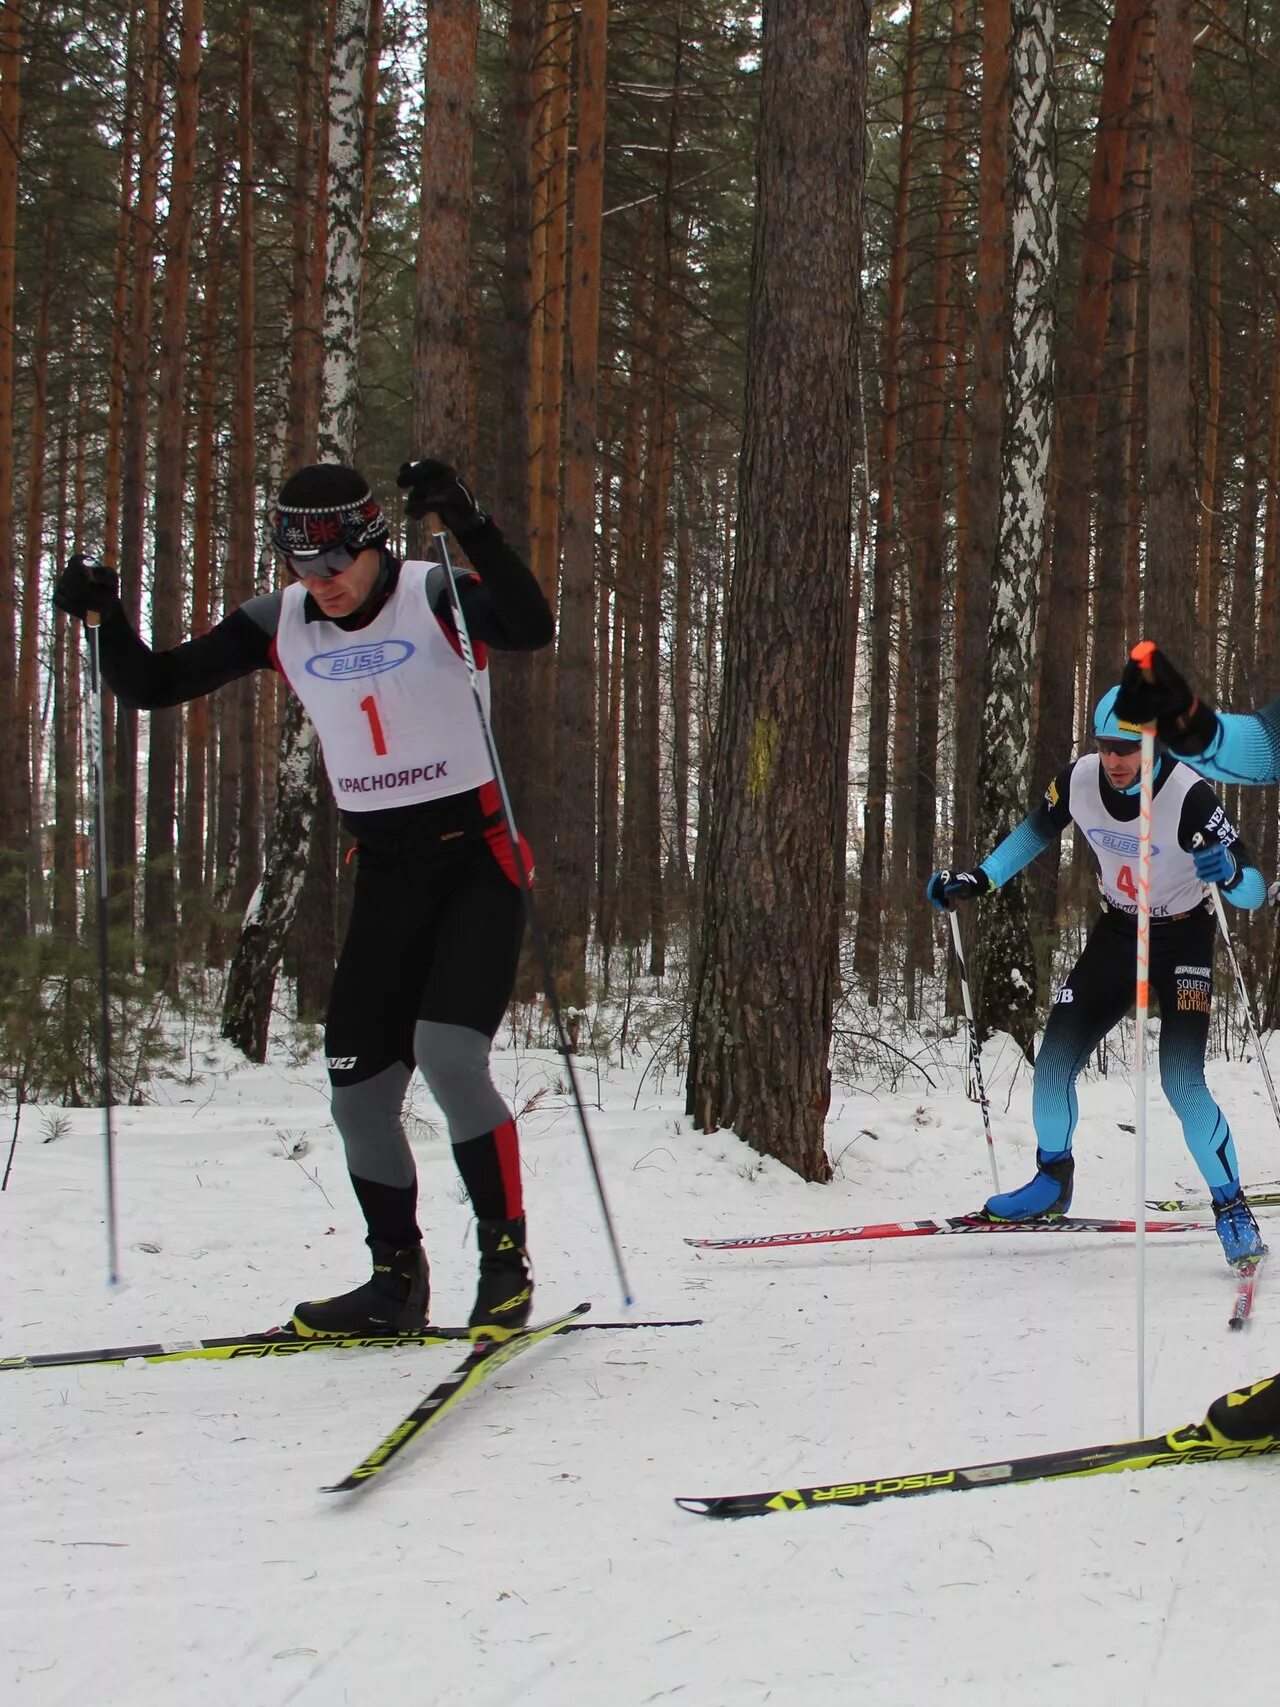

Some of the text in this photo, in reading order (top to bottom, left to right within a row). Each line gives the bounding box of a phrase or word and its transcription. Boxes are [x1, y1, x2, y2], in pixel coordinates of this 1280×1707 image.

[331, 650, 384, 673] BLISS
[360, 696, 388, 756] 1
[337, 761, 449, 793] КРАСНОЯРСК
[1102, 835, 1139, 853] BLISS
[1116, 865, 1139, 901] 4
[1176, 979, 1211, 993] SQUEEZY
[1177, 989, 1209, 1003] SPORTS
[934, 1224, 1103, 1235] MADSHUS
[812, 1471, 956, 1501] FISCHER
